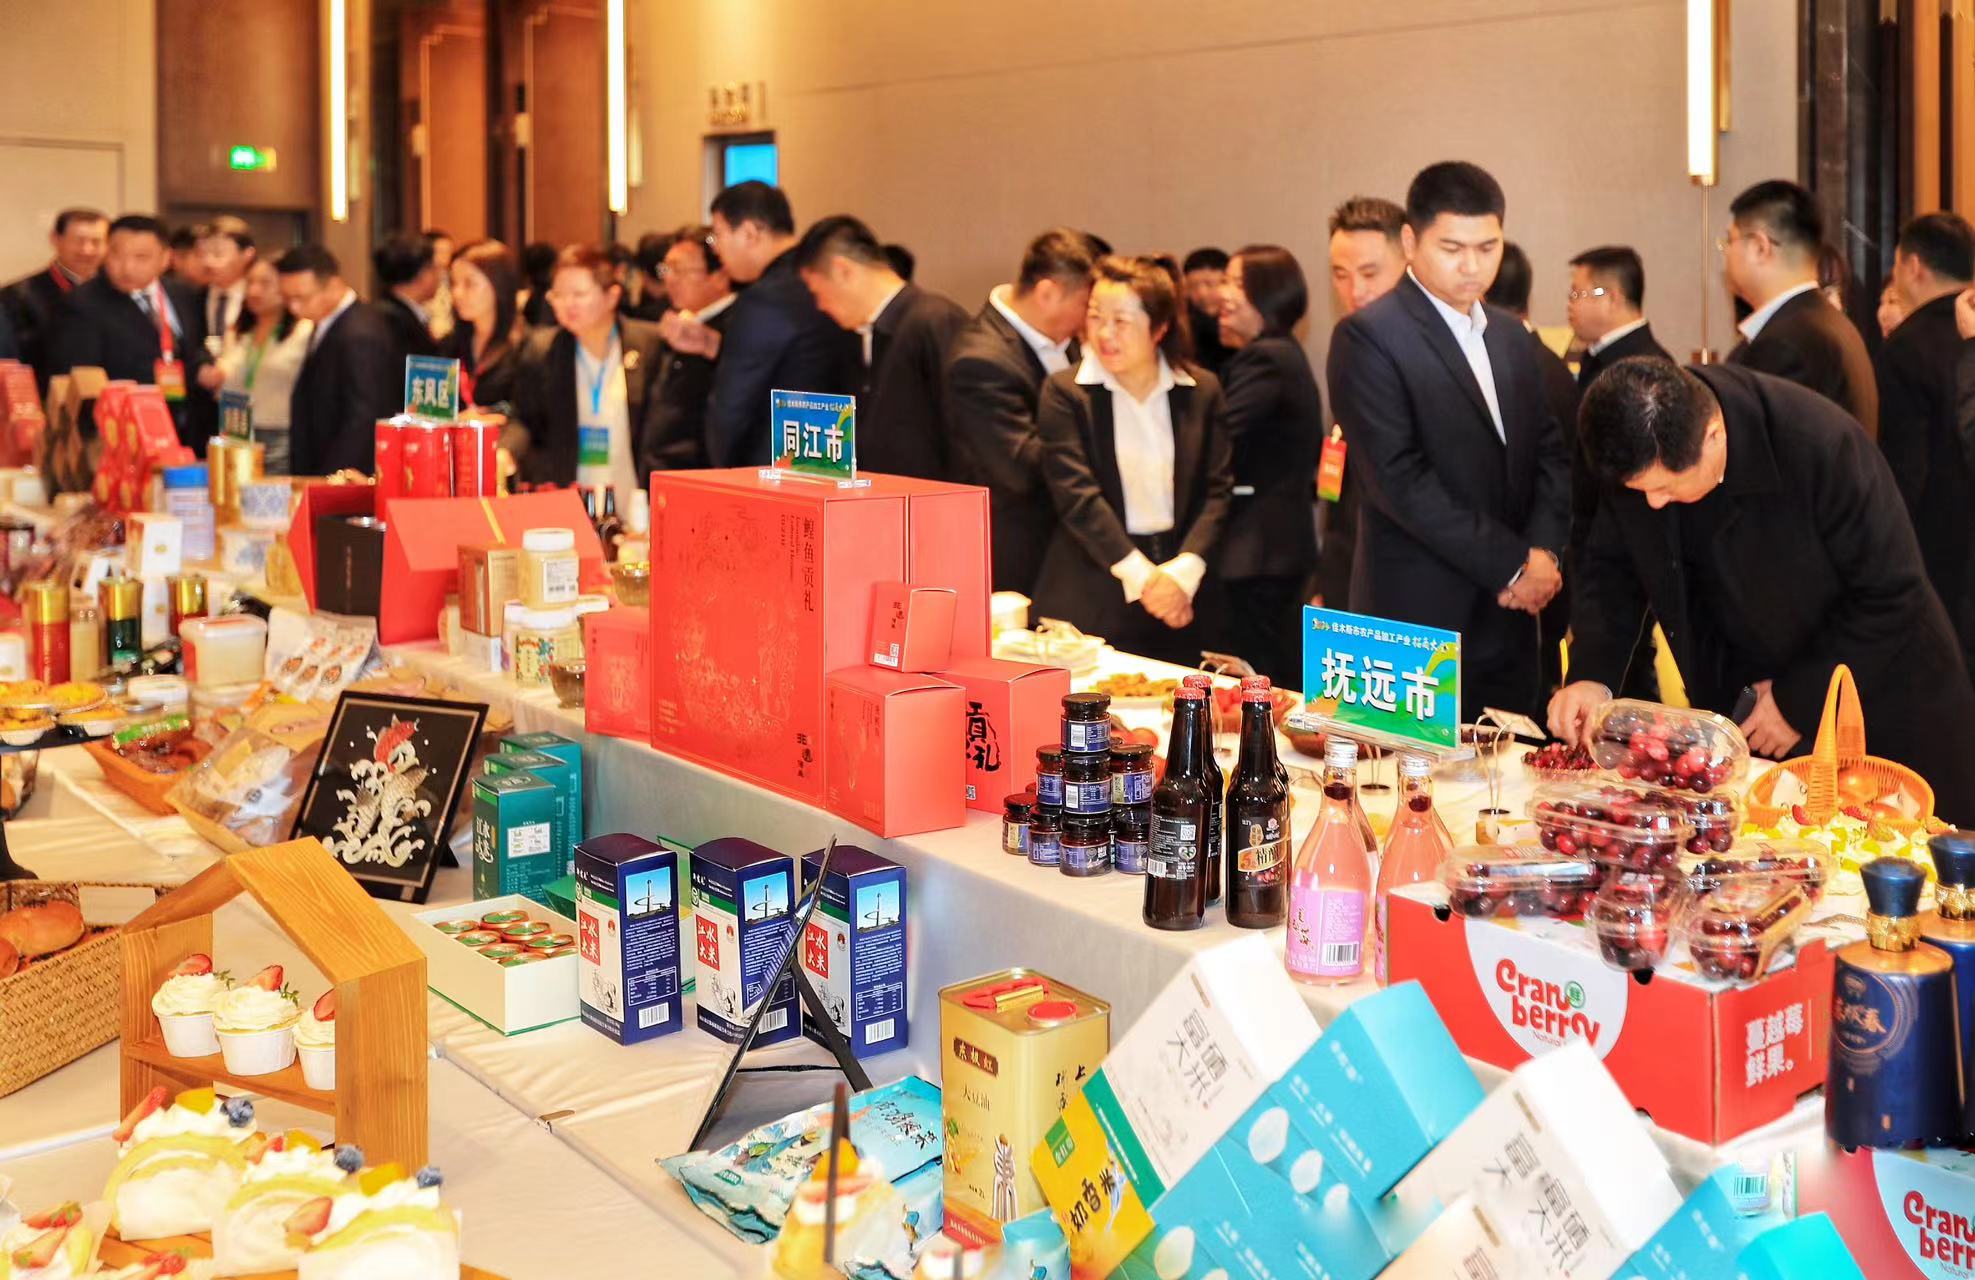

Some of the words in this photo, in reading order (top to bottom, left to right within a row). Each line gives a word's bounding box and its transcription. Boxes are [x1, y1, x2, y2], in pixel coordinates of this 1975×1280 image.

[412, 376, 450, 409] 东风区
[783, 420, 844, 463] 同江市
[1320, 648, 1439, 721] 抚远市
[580, 915, 599, 938] 江水
[698, 921, 717, 943] 江水
[806, 928, 827, 950] 江水
[581, 937, 599, 960] 大米
[699, 943, 718, 965] 大米
[807, 950, 827, 972] 大米
[1495, 958, 1571, 1011] Cran
[1512, 995, 1600, 1047] berry
[961, 1083, 990, 1111] 大豆油
[1069, 1168, 1116, 1232] 奶香米
[1903, 1190, 1975, 1243] Cran
